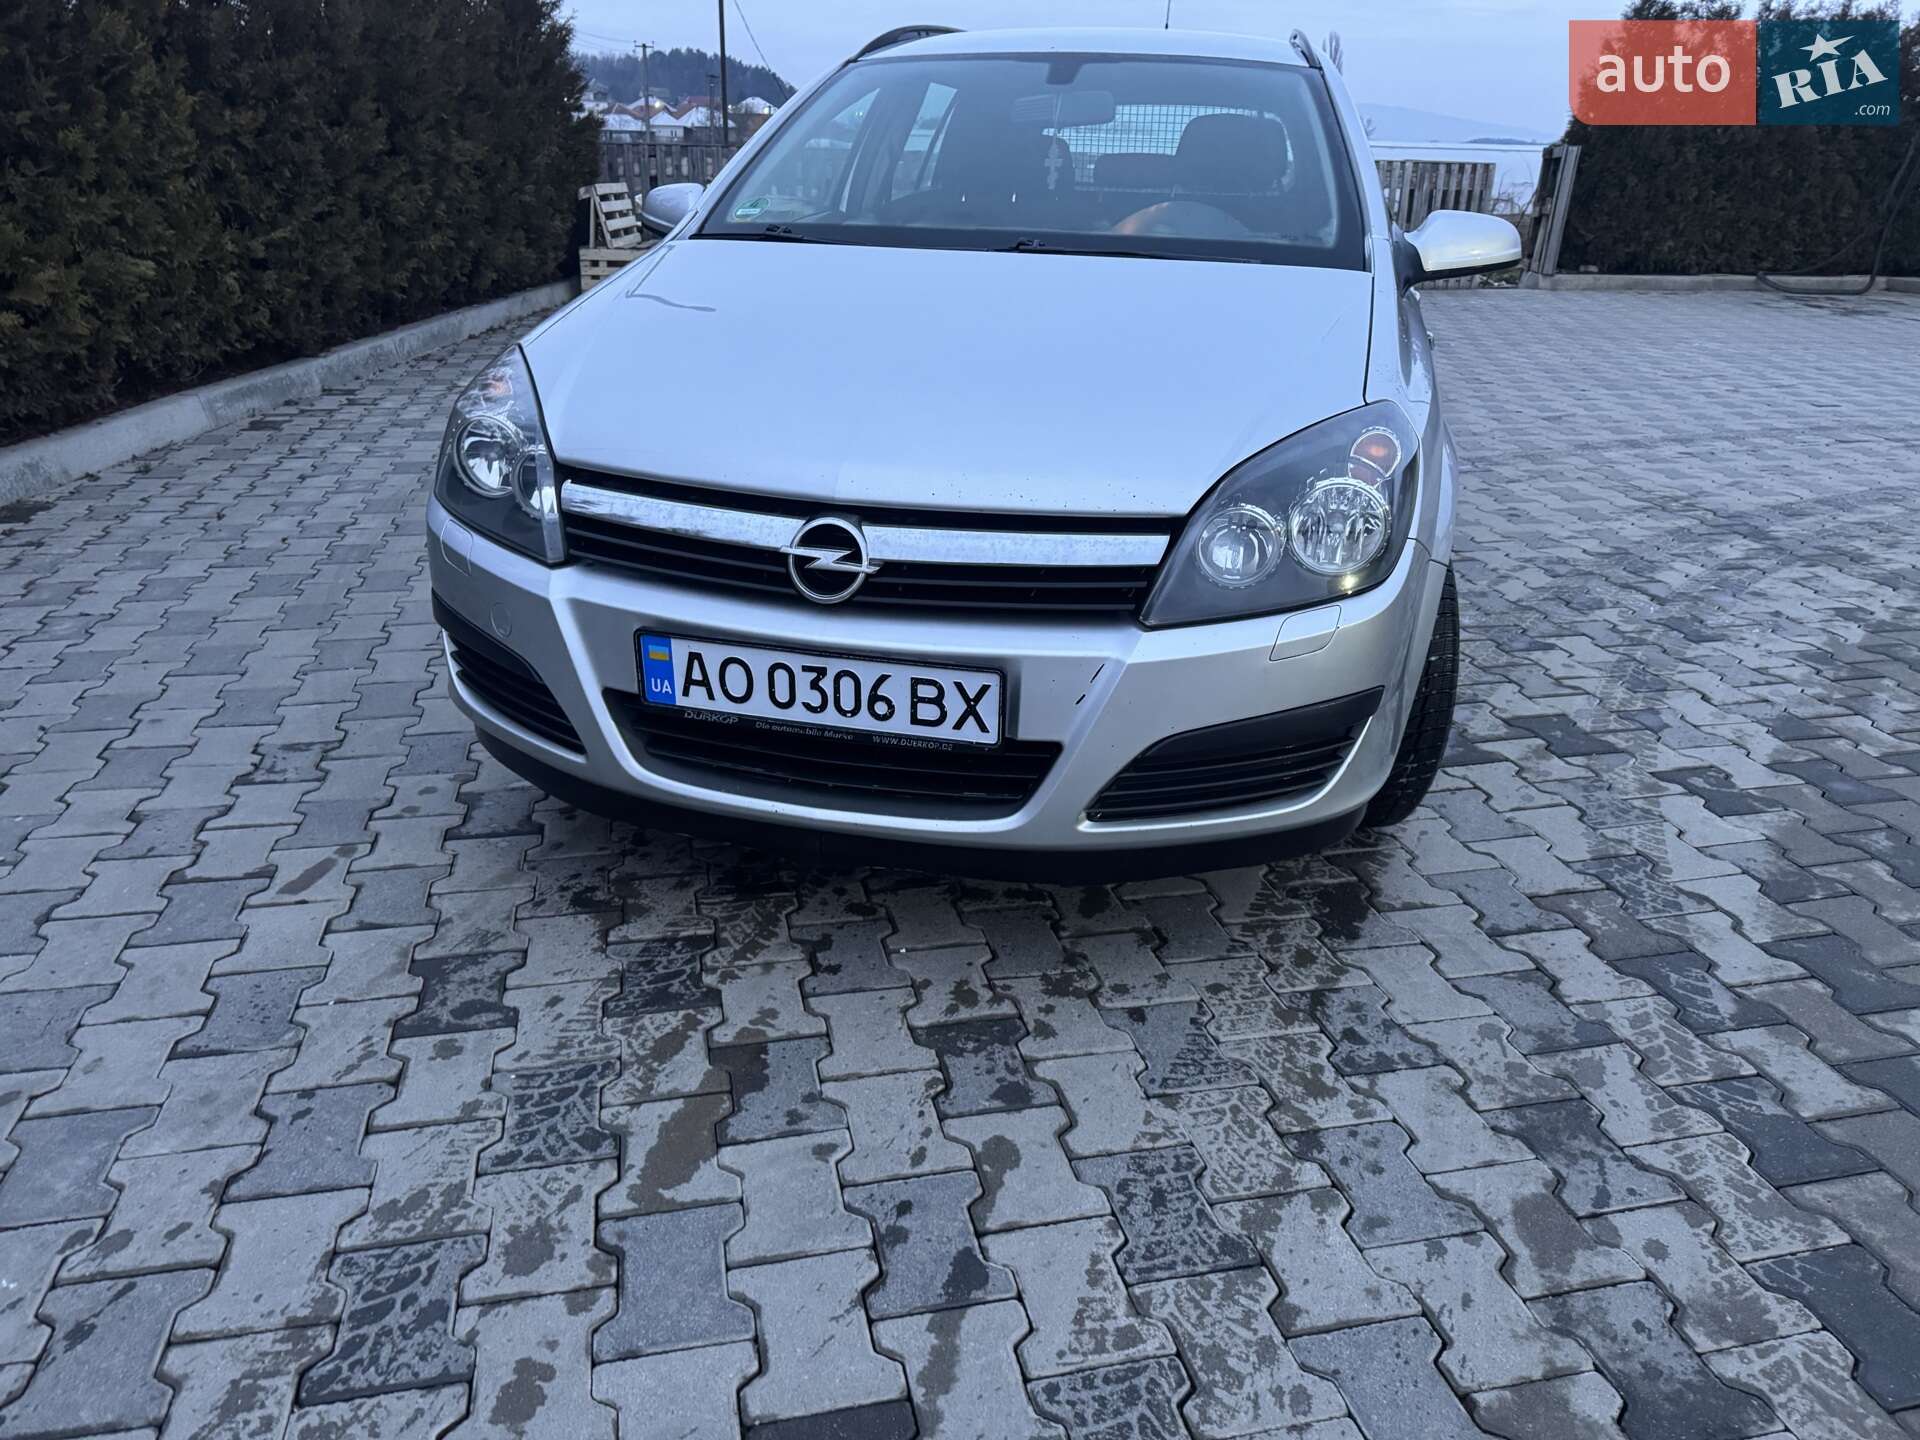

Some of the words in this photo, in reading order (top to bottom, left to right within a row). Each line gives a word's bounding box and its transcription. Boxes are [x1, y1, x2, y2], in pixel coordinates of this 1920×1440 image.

[651, 677, 673, 695] UA
[681, 651, 755, 705] AO
[767, 662, 896, 722] 0306
[909, 677, 992, 734] BX
